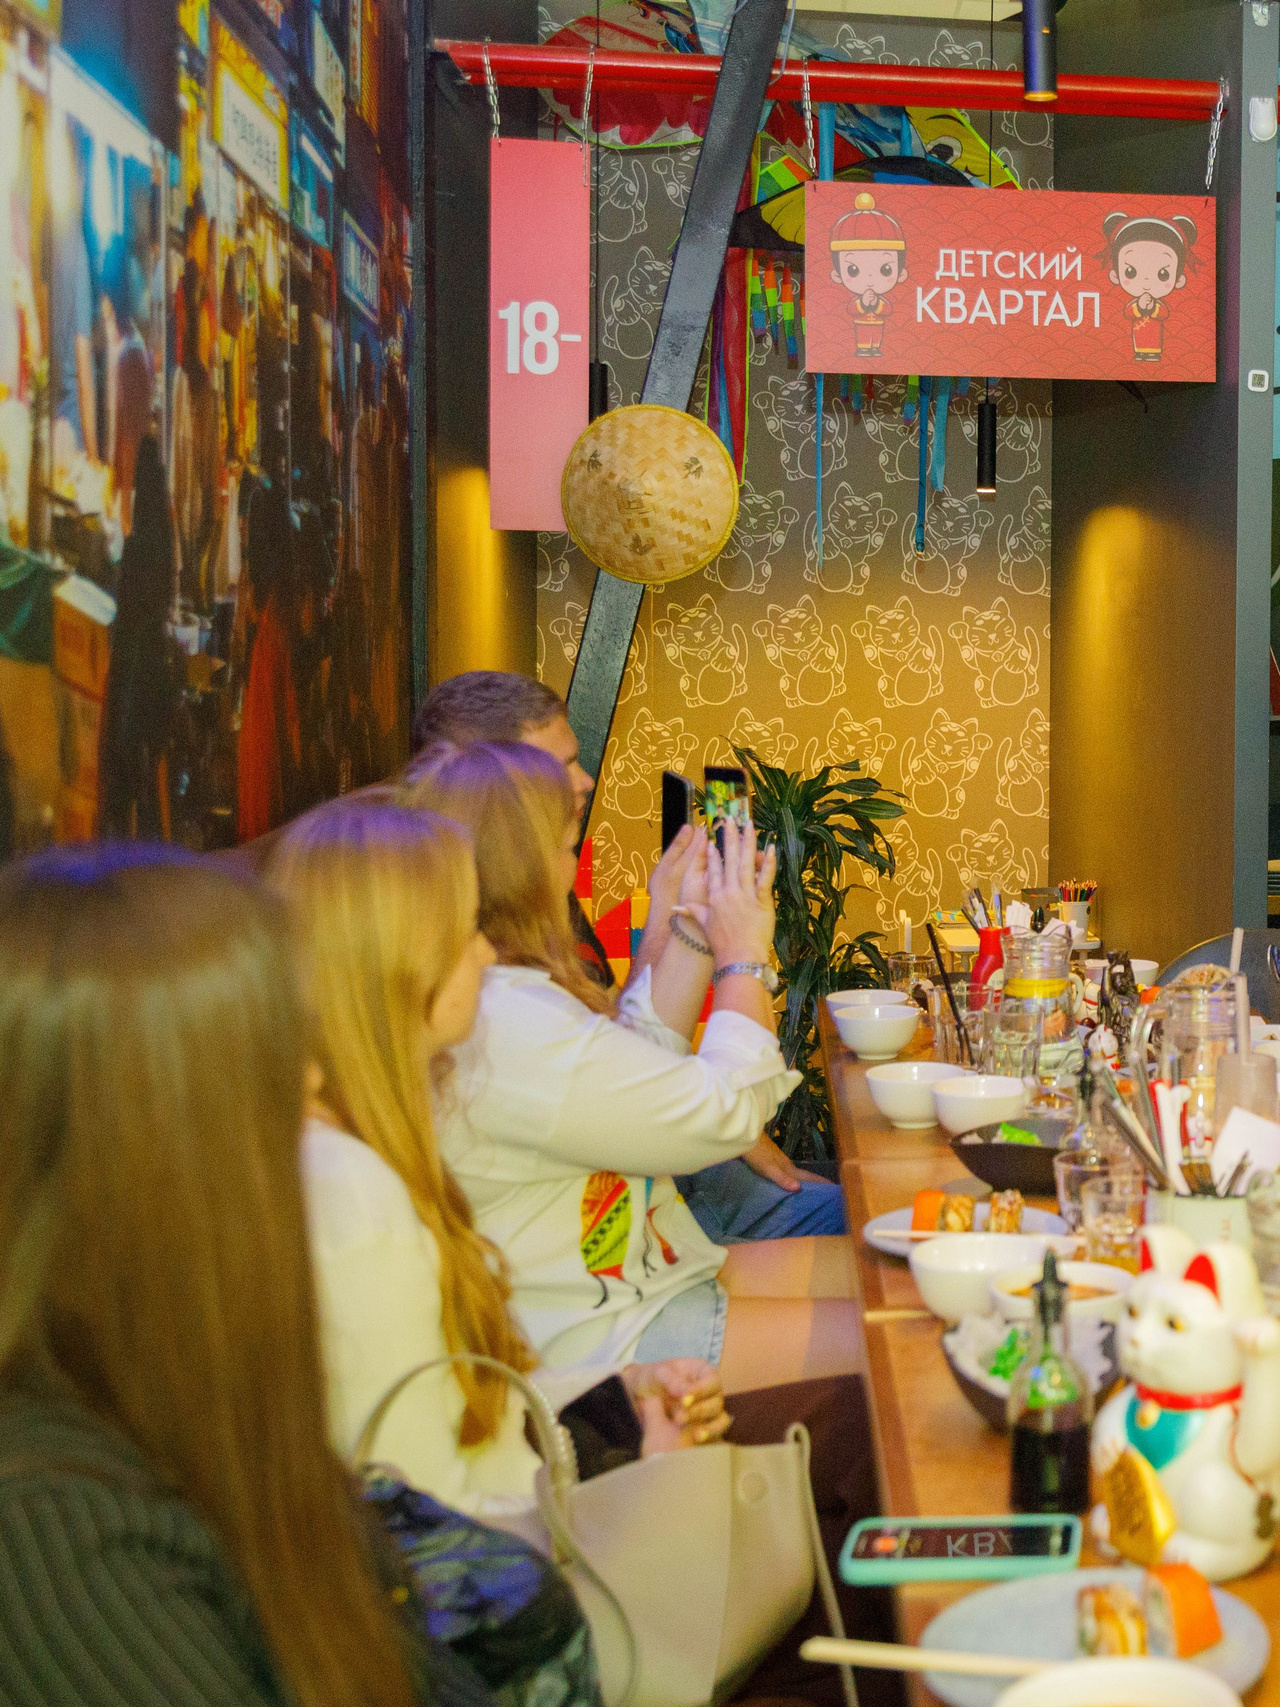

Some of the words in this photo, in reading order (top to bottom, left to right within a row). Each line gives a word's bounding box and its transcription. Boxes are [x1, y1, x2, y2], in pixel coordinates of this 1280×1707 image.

[935, 246, 1083, 282] ДЕТСКИЙ
[916, 286, 1101, 328] КВАРТАЛ
[498, 300, 582, 375] 18-
